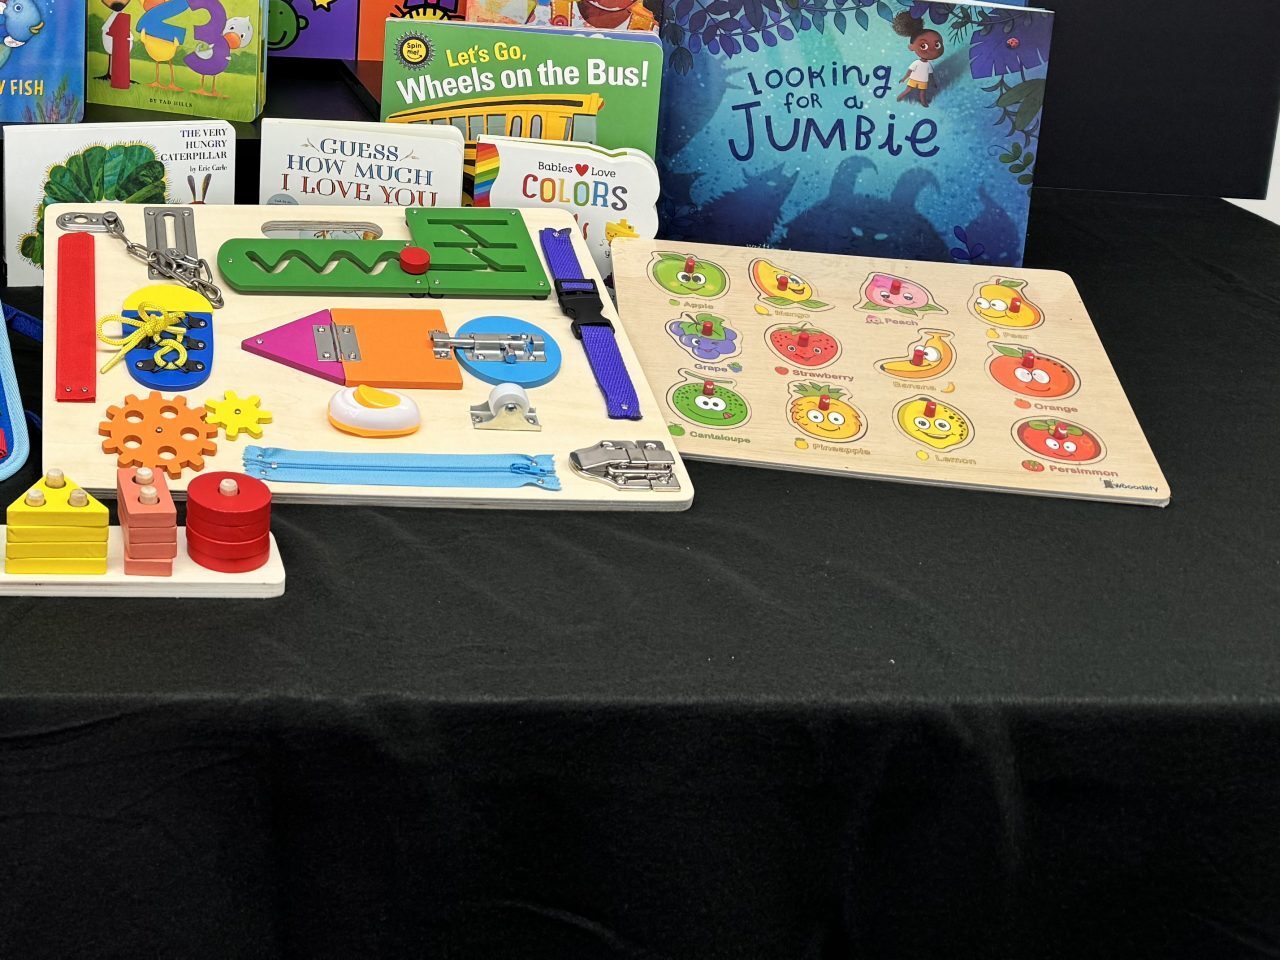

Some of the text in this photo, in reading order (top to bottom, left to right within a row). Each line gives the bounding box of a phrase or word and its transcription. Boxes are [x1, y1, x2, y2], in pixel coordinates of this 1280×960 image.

[107, 13, 133, 89] 1
[406, 42, 422, 50] Spin
[446, 42, 527, 68] Let's Go,
[10, 79, 44, 96] FISH
[396, 58, 649, 105] Wheels on the Bus!
[844, 96, 863, 109] a
[180, 128, 227, 138] THE VERY
[186, 140, 227, 149] HUNGRY
[320, 138, 399, 161] GUESS
[161, 151, 227, 161] CATERPILLAR
[189, 165, 196, 173] by
[198, 164, 210, 172] Eric
[287, 154, 433, 186] HOW MUCH
[538, 161, 616, 178] Babies Love
[281, 173, 438, 207] I LOVE YOU
[522, 174, 628, 211] COLORS
[1034, 402, 1078, 413] Orange
